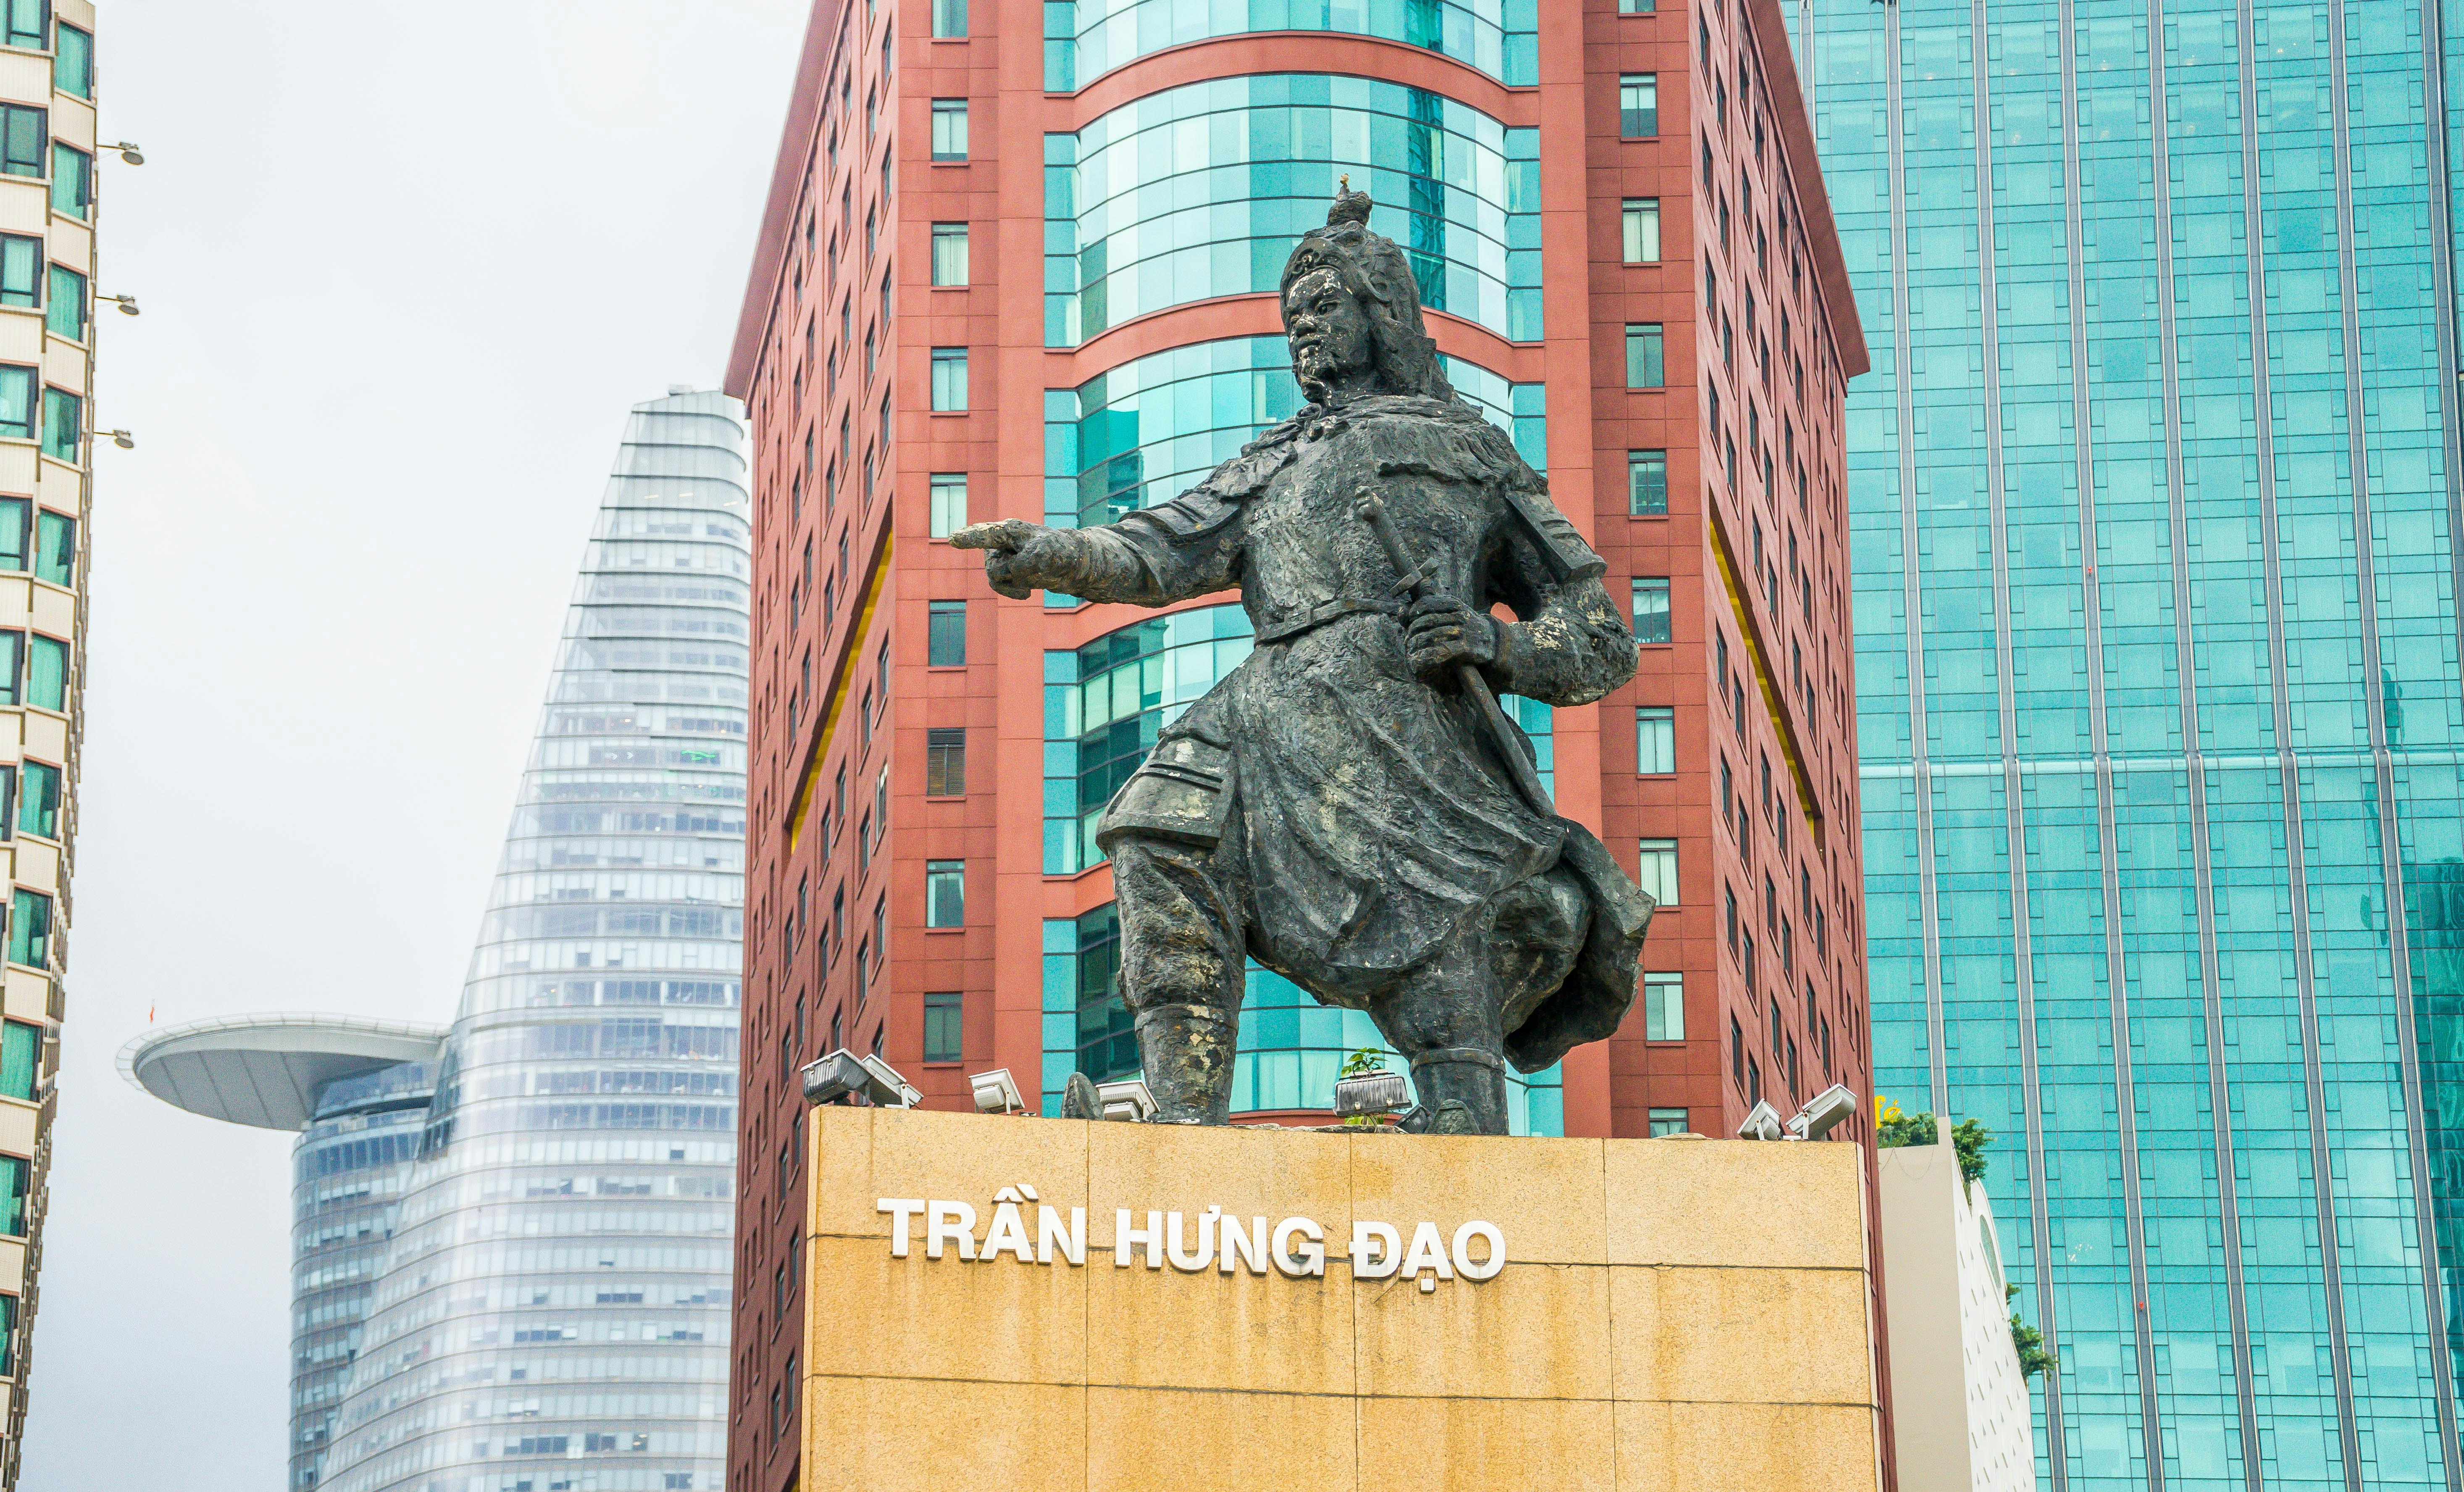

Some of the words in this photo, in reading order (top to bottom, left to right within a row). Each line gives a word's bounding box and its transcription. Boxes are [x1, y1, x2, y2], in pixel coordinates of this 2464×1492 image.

[877, 1183, 1086, 1266] TRẦN
[1115, 1204, 1325, 1278] HƯNG
[1348, 1219, 1507, 1293] ĐẠO
